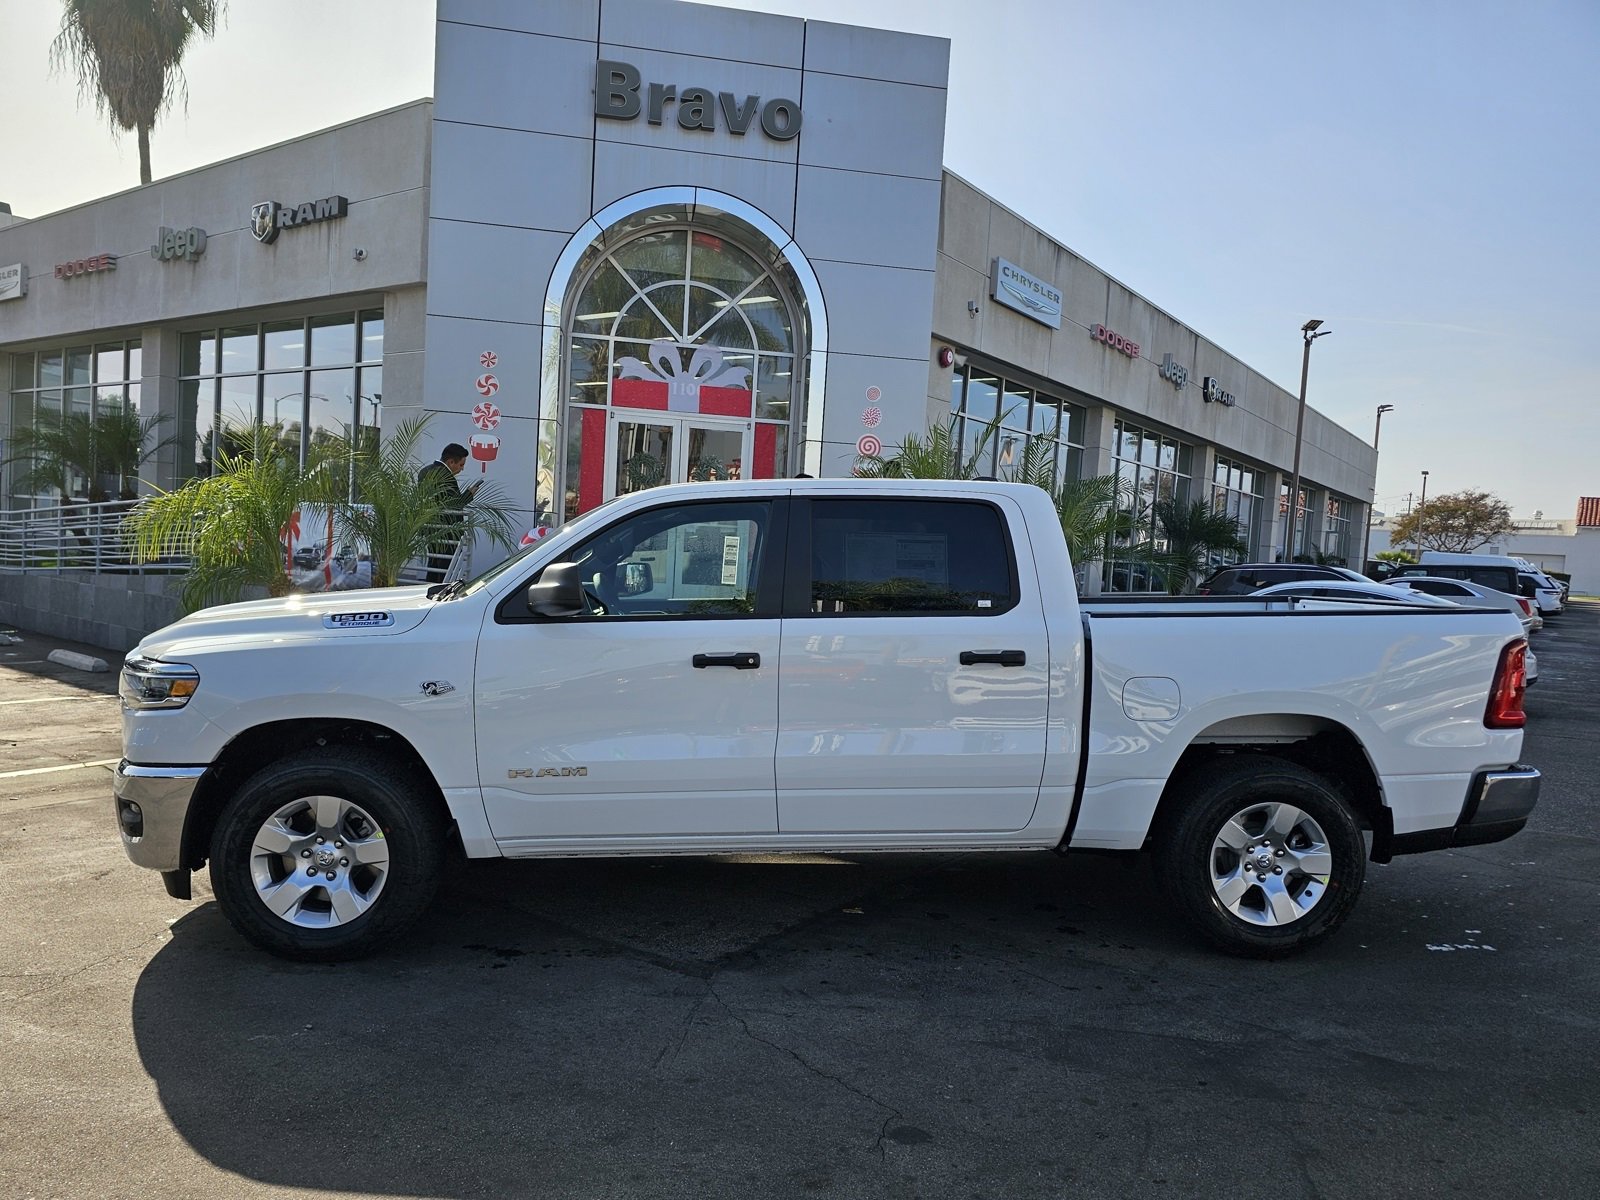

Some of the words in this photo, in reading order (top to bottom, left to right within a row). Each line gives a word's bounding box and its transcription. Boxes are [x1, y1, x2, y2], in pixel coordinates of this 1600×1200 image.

[596, 59, 803, 141] Bravo
[277, 195, 344, 229] RAM
[151, 226, 204, 262] Jeep
[0, 268, 19, 281] LER
[55, 253, 112, 279] DODGE
[1002, 266, 1060, 304] CHRYSLER
[1095, 323, 1140, 359] DODGE
[1160, 353, 1189, 391] Jeep
[1216, 387, 1236, 407] RAM
[334, 613, 384, 622] 1500
[508, 767, 587, 778] RAM
